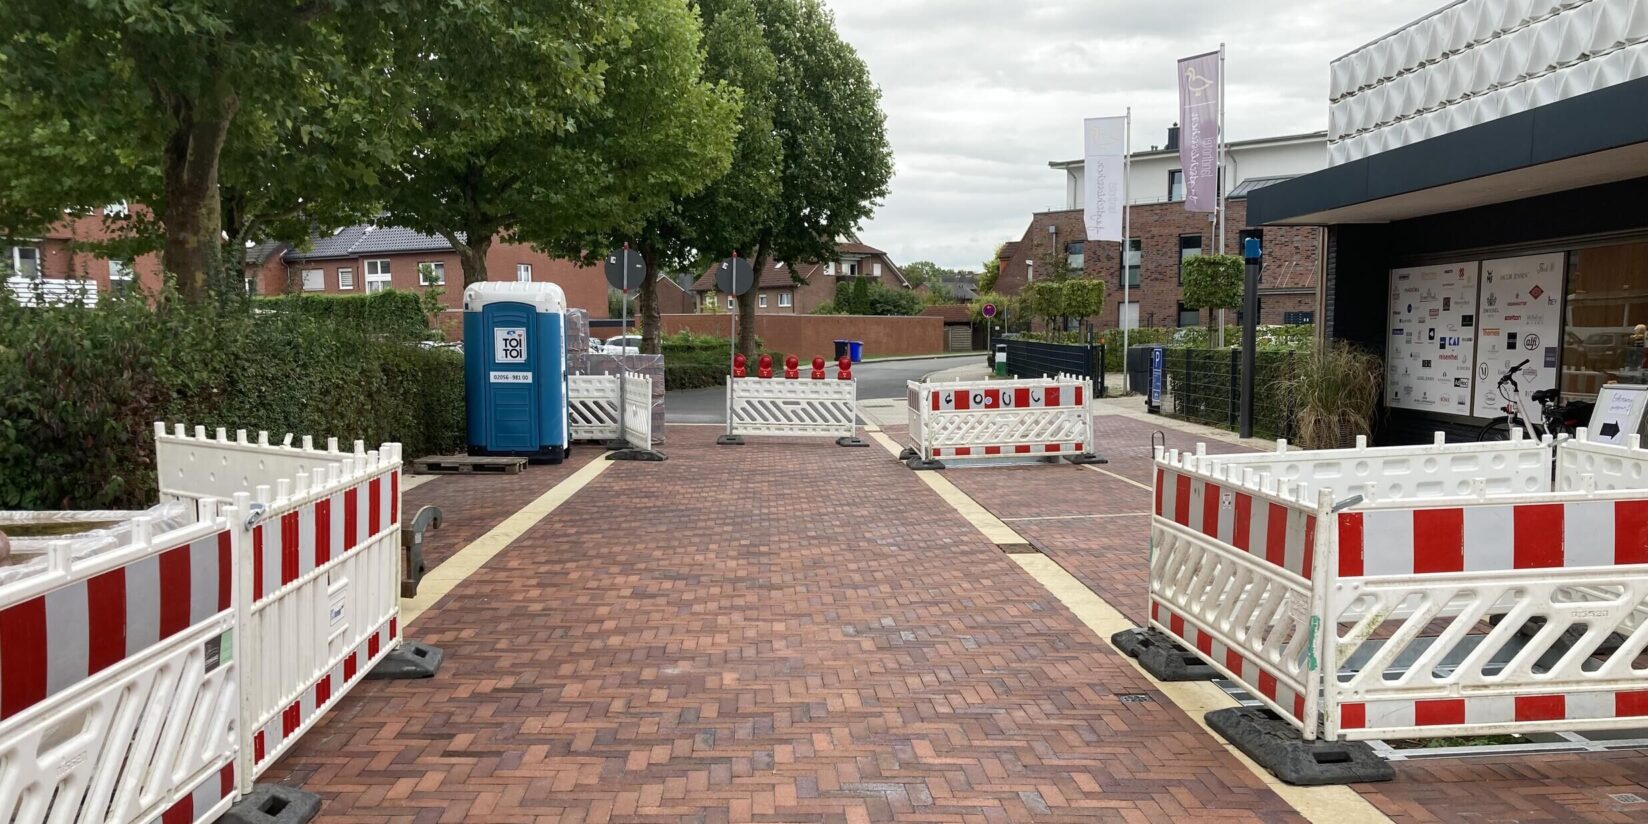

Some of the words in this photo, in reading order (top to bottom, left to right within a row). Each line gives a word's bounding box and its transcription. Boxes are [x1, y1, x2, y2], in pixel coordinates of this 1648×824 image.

[503, 338, 522, 348] TOI
[1526, 336, 1537, 350] alfi
[503, 348, 522, 359] TOI
